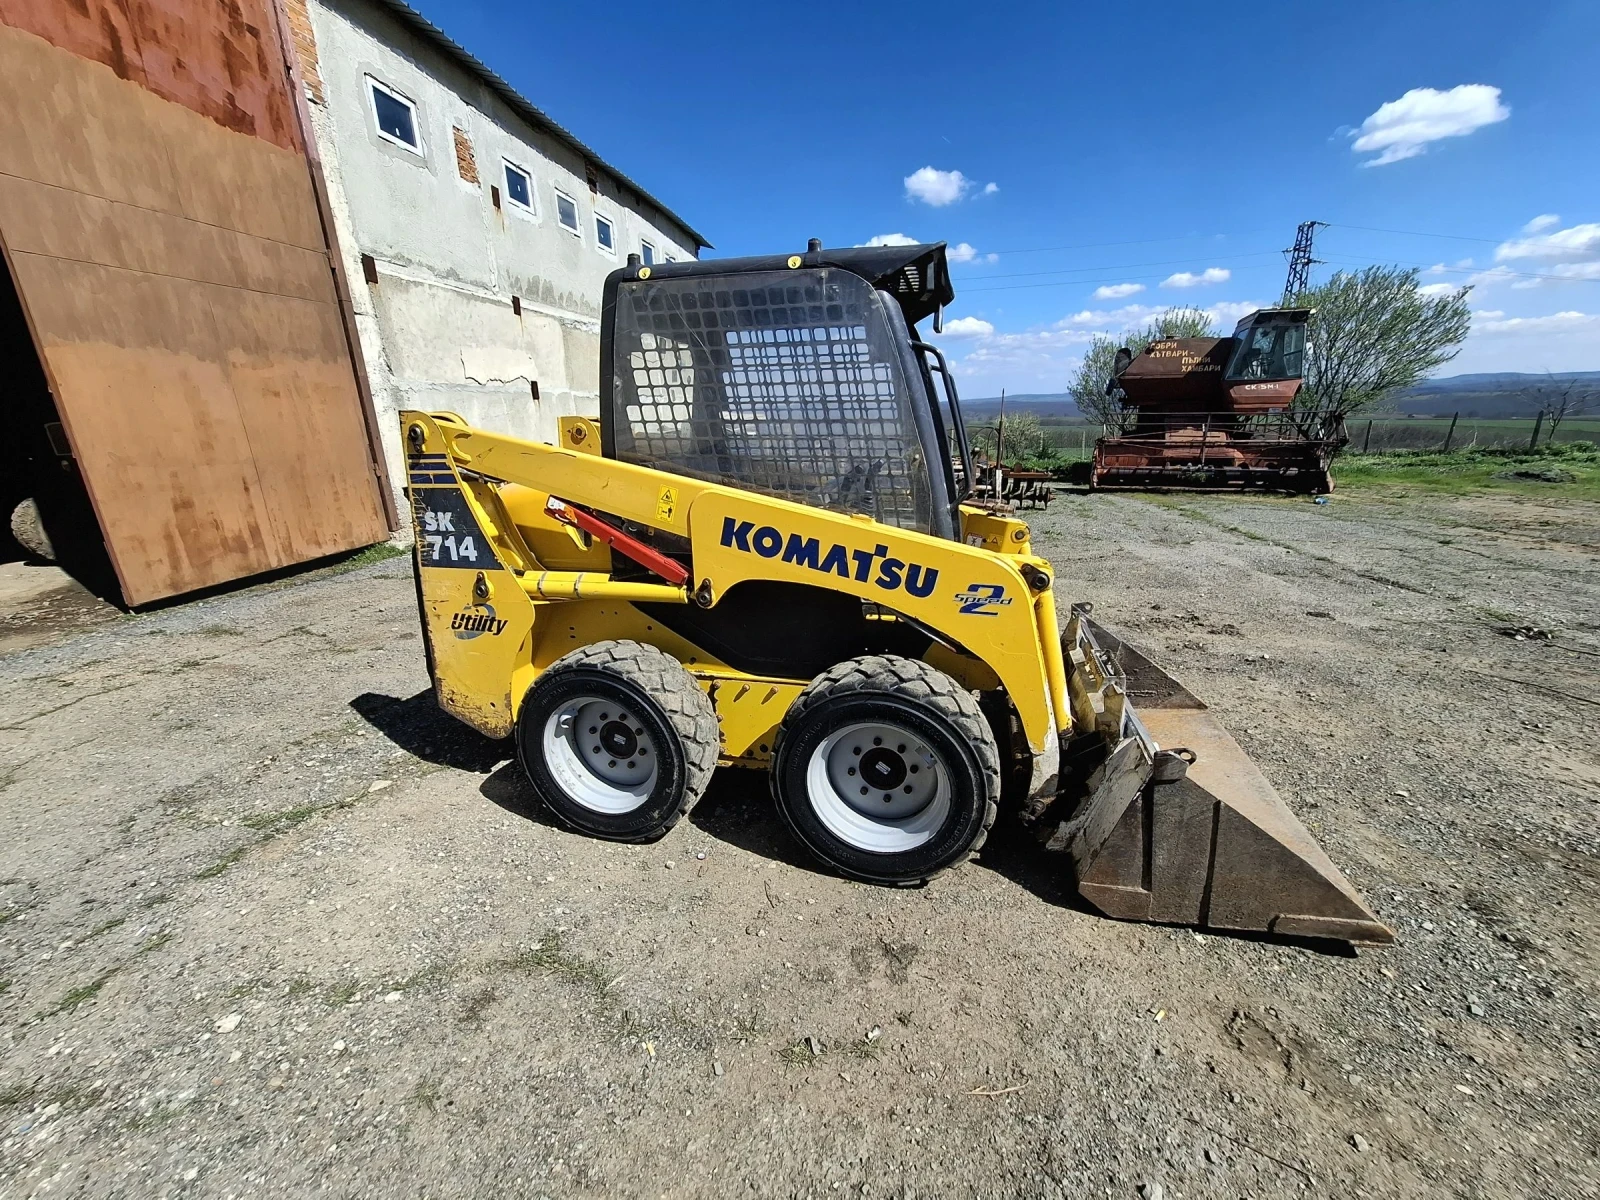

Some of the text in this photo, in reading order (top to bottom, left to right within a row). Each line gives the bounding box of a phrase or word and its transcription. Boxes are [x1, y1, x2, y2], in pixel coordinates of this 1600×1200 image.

[424, 511, 455, 532] SK
[425, 535, 478, 562] 714
[719, 516, 939, 598] KOMATSU
[450, 612, 508, 636] Utility
